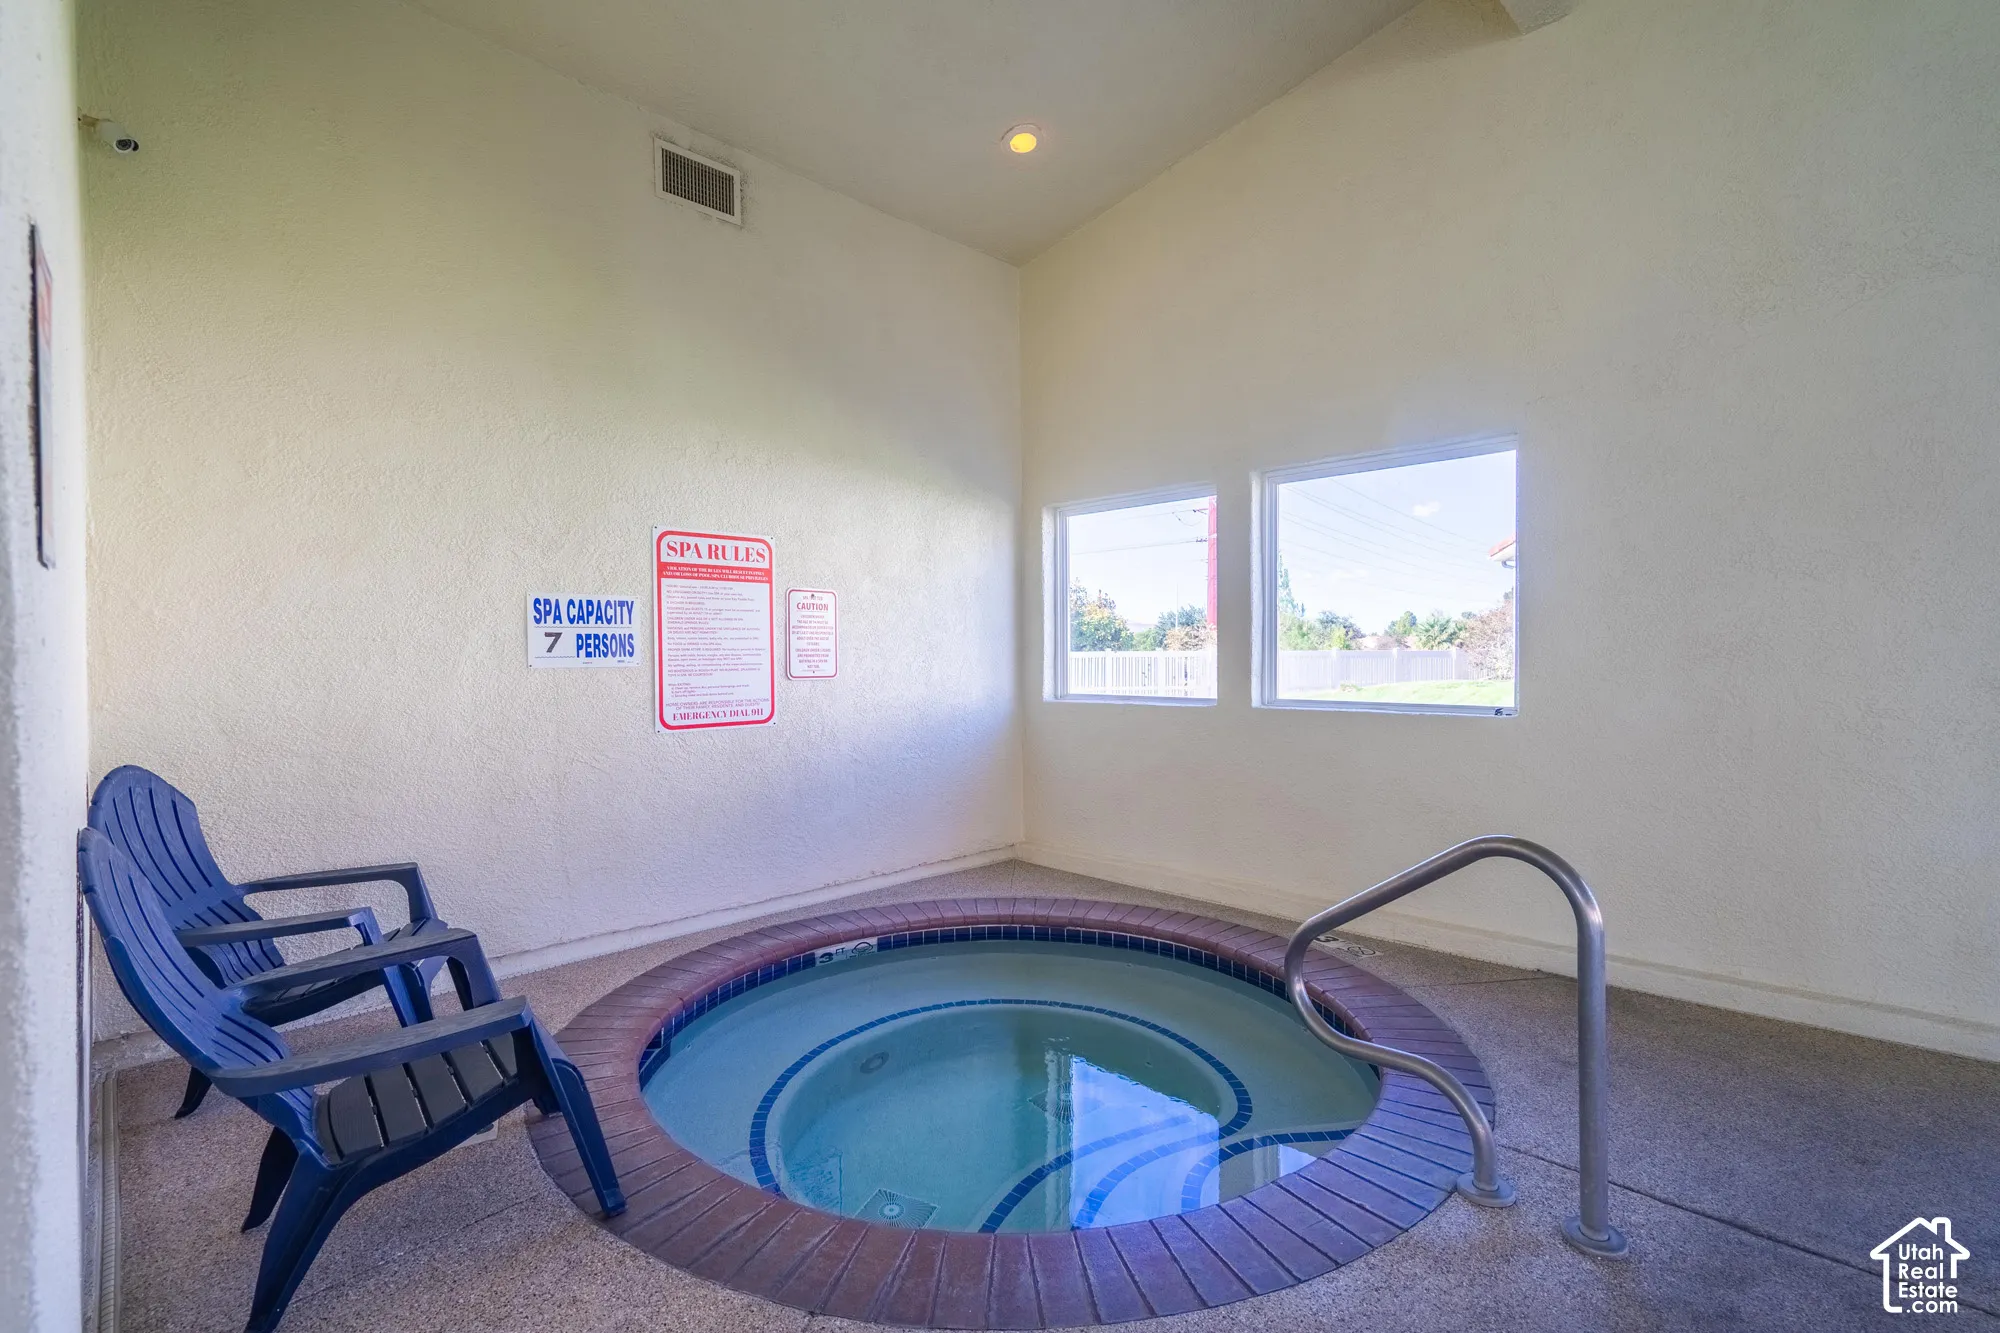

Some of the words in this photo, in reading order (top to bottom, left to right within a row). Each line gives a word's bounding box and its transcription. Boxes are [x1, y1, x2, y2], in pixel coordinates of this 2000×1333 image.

[667, 541, 703, 560] SPA
[707, 543, 766, 563] RULES
[533, 597, 563, 625] SPA
[566, 598, 634, 625] CAPACITY
[796, 602, 829, 611] CAUTION
[544, 631, 563, 653] 7
[576, 632, 635, 658] PERSONS
[673, 710, 727, 721] EMERGENCY
[730, 708, 751, 718] DIAL
[751, 707, 764, 716] 911
[819, 951, 834, 964] 3
[835, 947, 846, 955] FT
